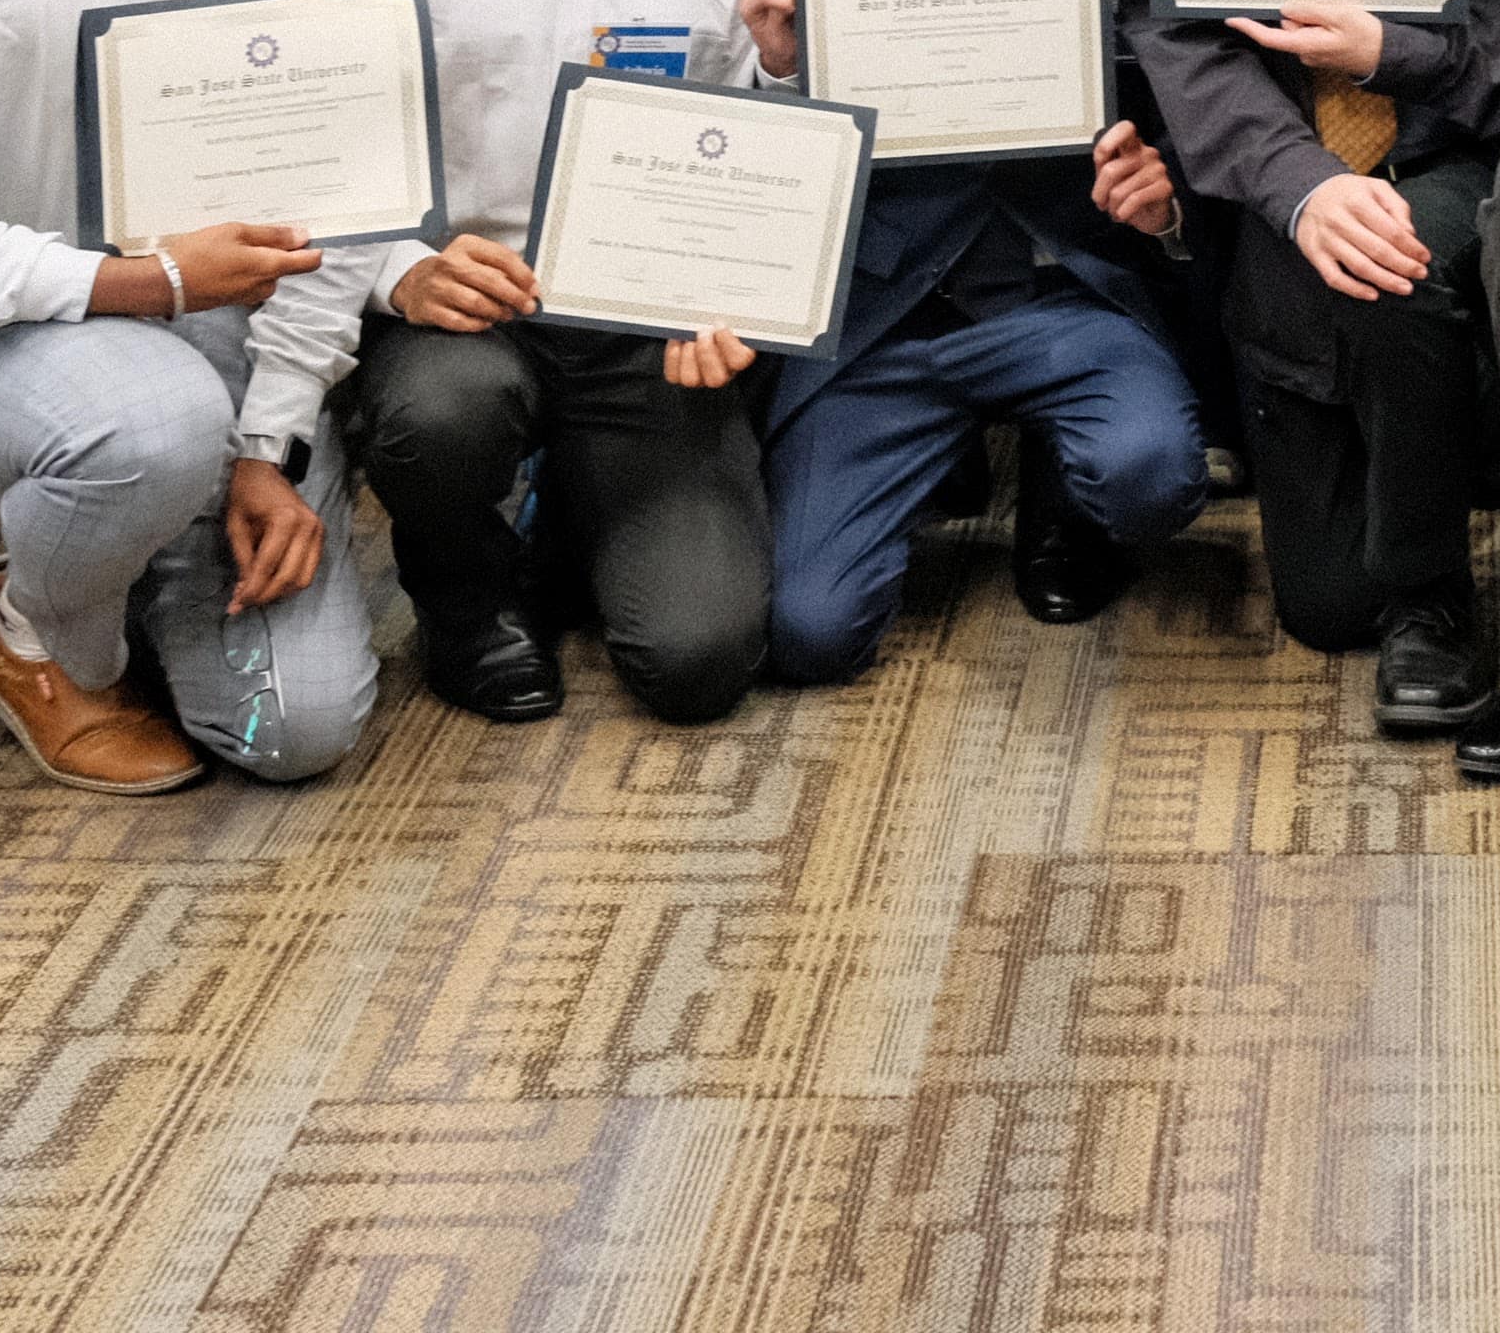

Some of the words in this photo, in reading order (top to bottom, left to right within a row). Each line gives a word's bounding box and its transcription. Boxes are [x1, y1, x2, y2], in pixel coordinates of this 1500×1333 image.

[160, 84, 194, 98] San
[241, 74, 283, 88] State
[287, 62, 368, 83] University
[612, 151, 642, 167] San
[685, 161, 724, 178] State
[728, 166, 802, 188] University
